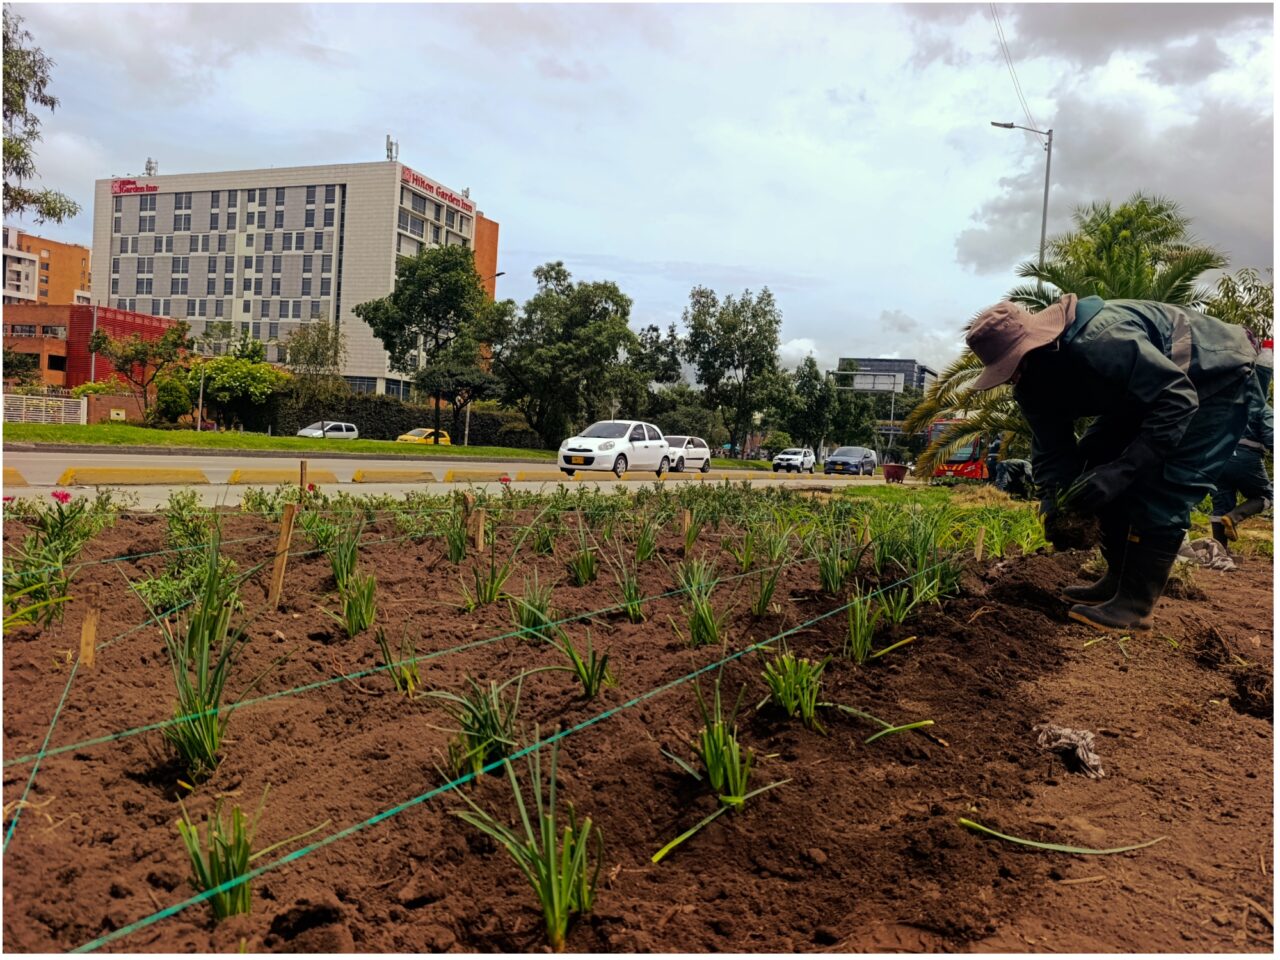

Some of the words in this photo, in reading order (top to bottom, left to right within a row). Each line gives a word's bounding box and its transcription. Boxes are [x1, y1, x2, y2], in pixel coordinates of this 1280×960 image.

[412, 173, 434, 193] Hilton
[436, 186, 461, 207] Garden
[461, 200, 473, 213] Inn
